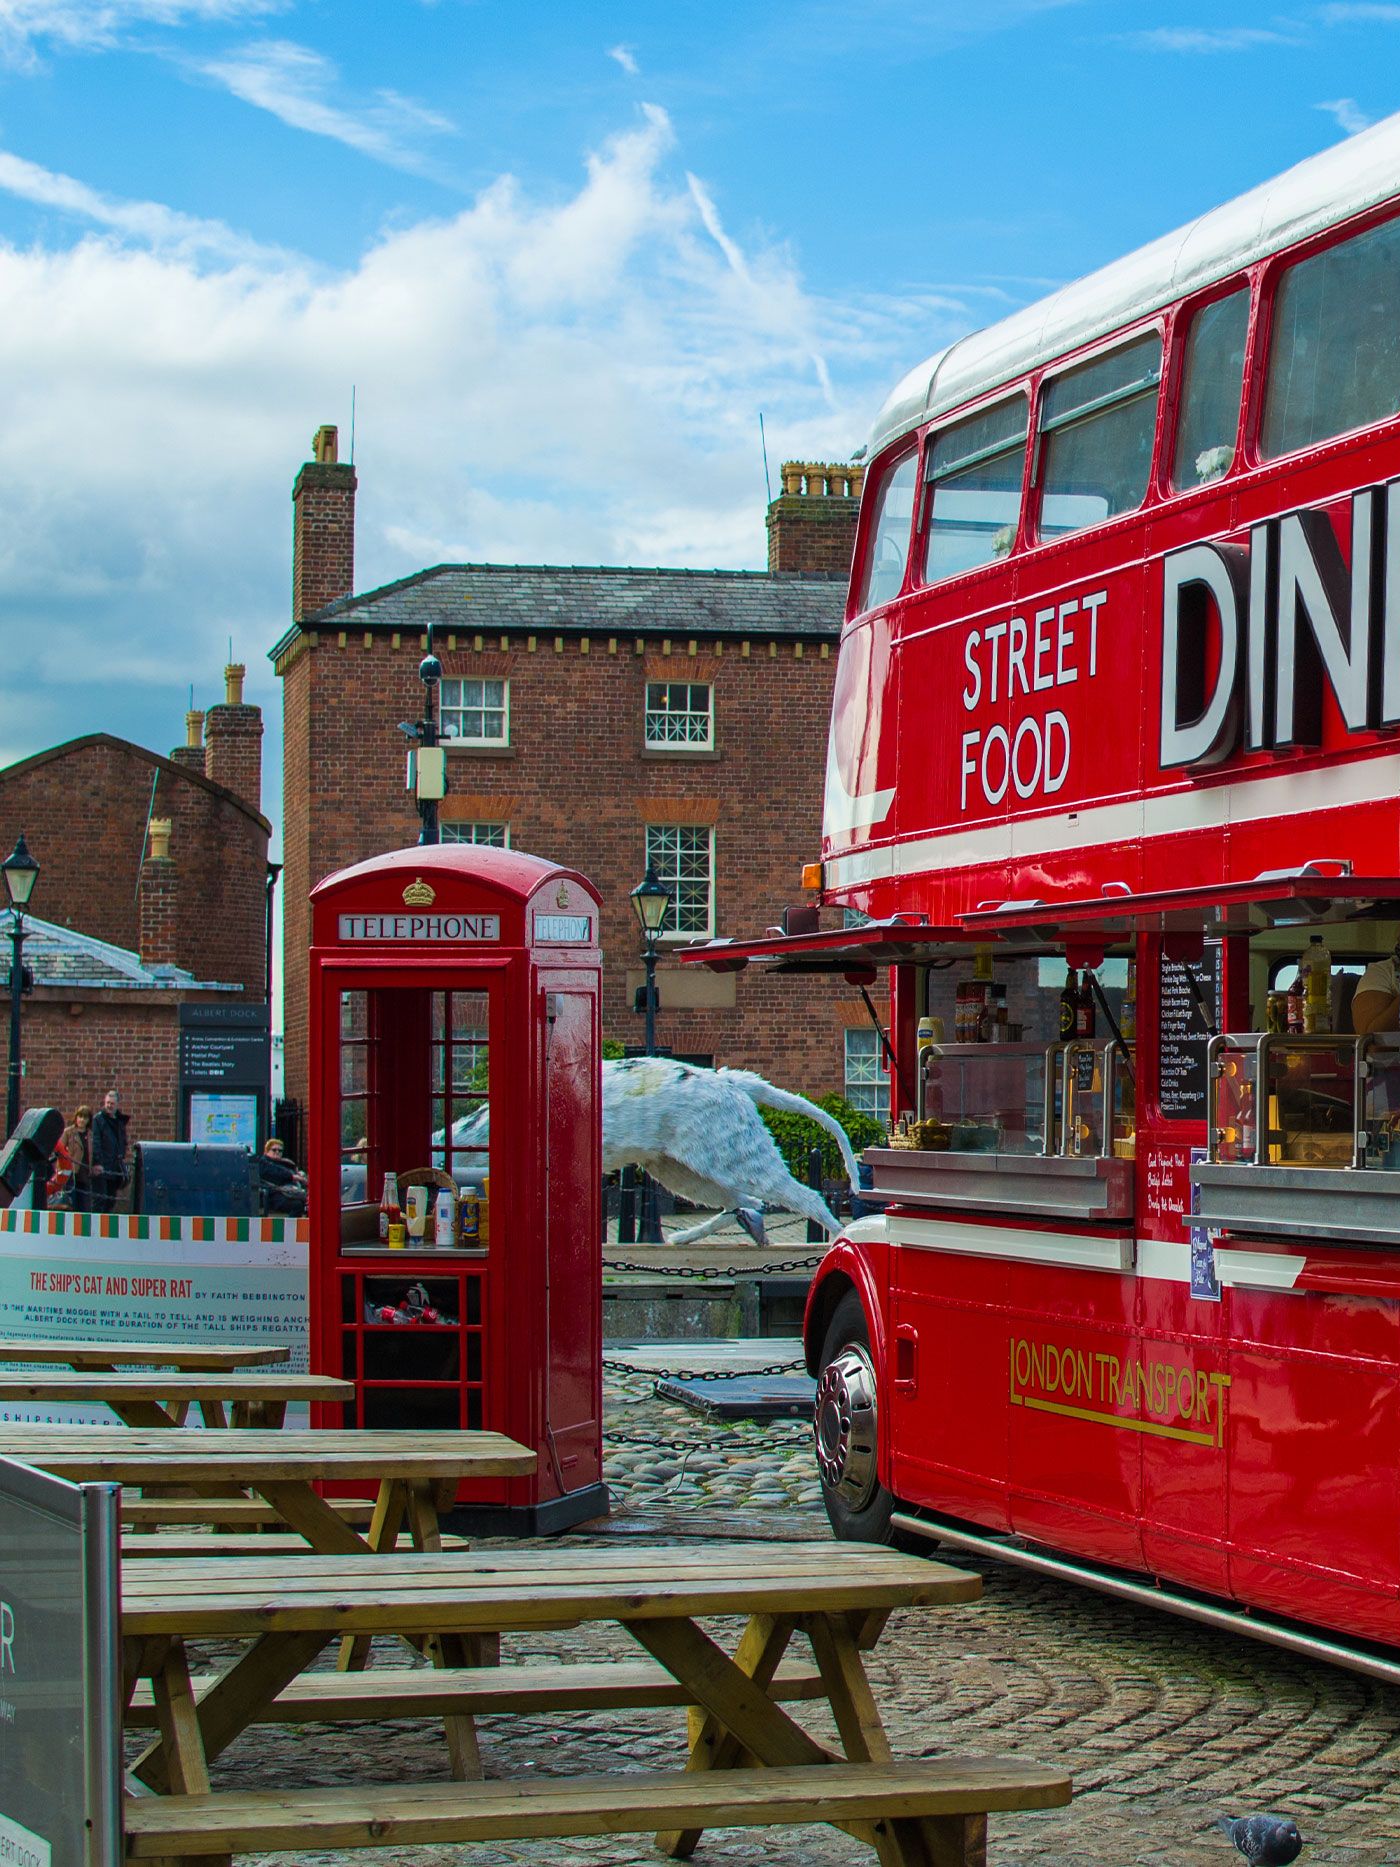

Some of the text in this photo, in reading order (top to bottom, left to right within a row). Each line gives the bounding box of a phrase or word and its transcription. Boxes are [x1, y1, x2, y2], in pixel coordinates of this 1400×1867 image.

[963, 590, 1108, 712] STREET
[960, 710, 1071, 812] FOOD
[345, 917, 494, 939] TELEPHONE
[192, 1009, 257, 1017] ALBERT DOCK
[30, 1272, 193, 1298] THE SHIP'S CAT AND SUPER RAT
[211, 1292, 238, 1300] FAITH
[243, 1293, 305, 1301] BEBBINGTON
[11, 1304, 24, 1312] THE
[67, 1308, 97, 1317] MOGGIE
[100, 1310, 121, 1318] WITH
[133, 1312, 151, 1320] TAIL
[171, 1313, 191, 1321] TELL
[195, 1314, 215, 1322] AND
[219, 1314, 227, 1322] IS
[231, 1314, 279, 1323] WEIGHING
[25, 1315, 53, 1323] ALBERT
[120, 1320, 163, 1328] DURATION
[204, 1323, 226, 1331] TALL
[230, 1324, 258, 1332] SHIPS
[1009, 1337, 1232, 1448] LONDON TRANSPORT
